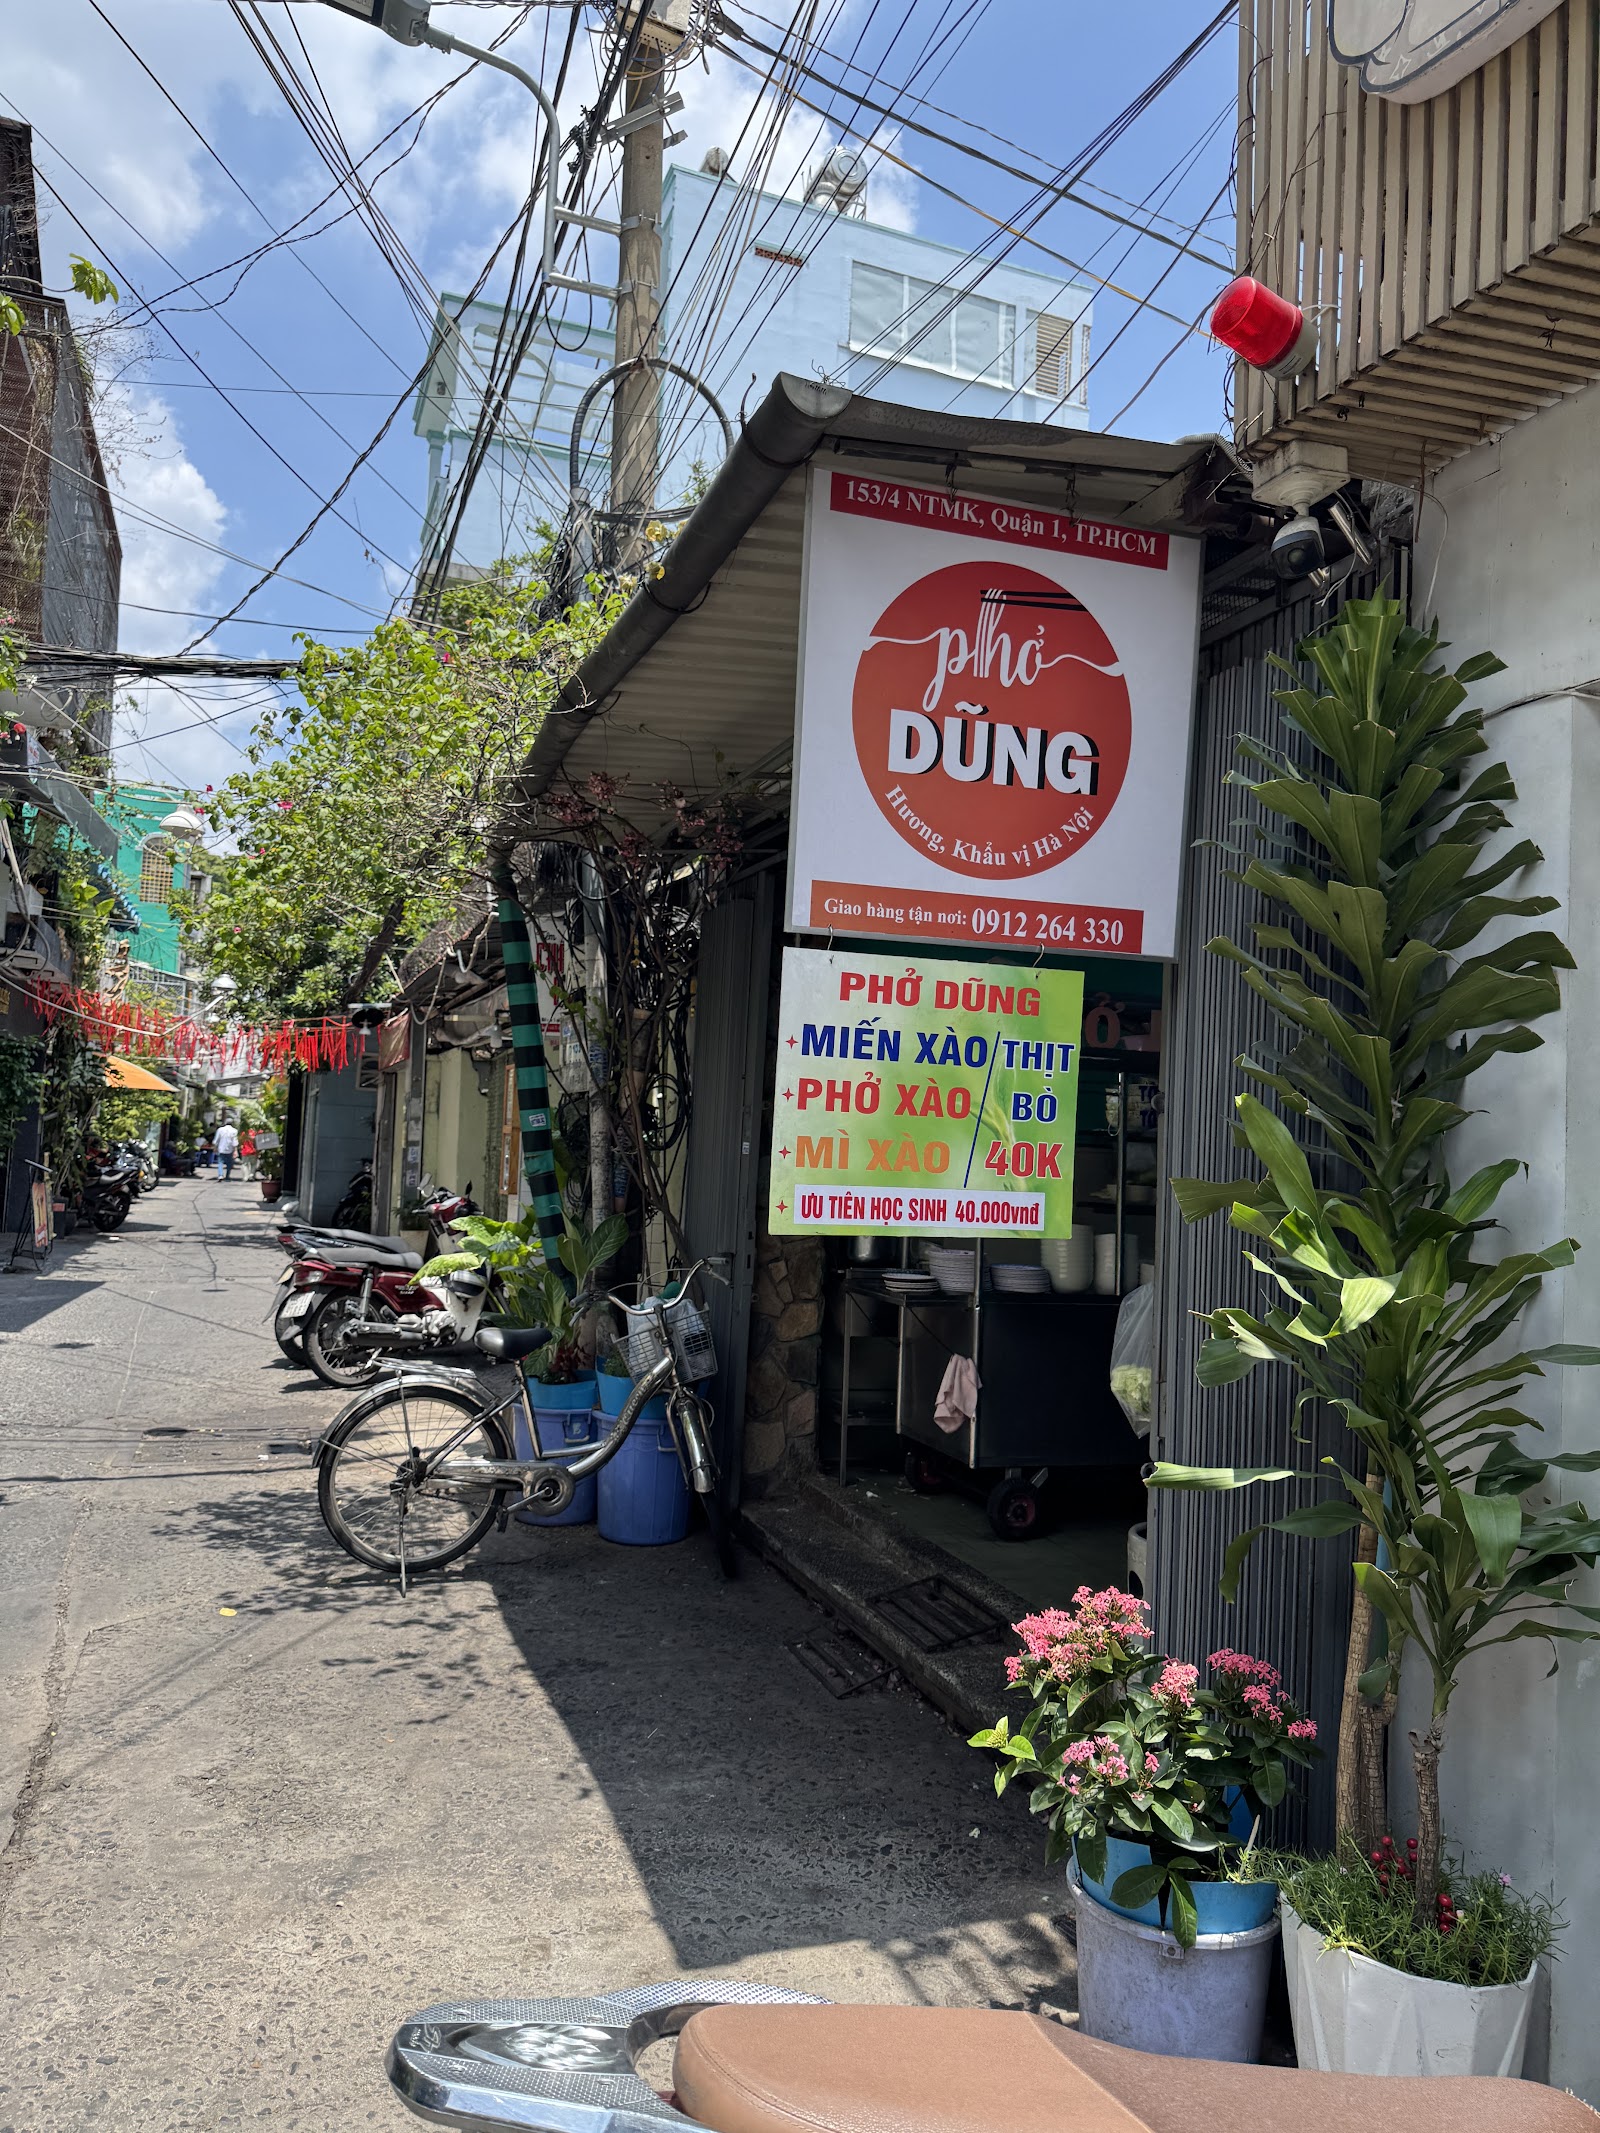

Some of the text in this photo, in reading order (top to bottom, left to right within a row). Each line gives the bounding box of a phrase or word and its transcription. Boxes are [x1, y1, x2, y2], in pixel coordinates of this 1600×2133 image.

[846, 480, 1157, 556] 153/4 NTMK, Quận 1, TP.HCM
[921, 588, 1047, 713] phở
[887, 701, 1100, 796] DŨNG
[885, 784, 1094, 867] Hương, Khẩu vị Hà Nội
[824, 898, 1124, 946] Giao hàng tận nơi: 0912 264 330
[839, 967, 1041, 1017] PHỞ DŨNG
[801, 1016, 988, 1068] MIẾN XÀO
[1001, 1038, 1076, 1079] THỊT
[797, 1071, 971, 1119] PHỞ XÀO
[1011, 1086, 1058, 1124] BÒ
[795, 1128, 950, 1174] MÌ XÀO
[984, 1140, 1064, 1180] 40K
[801, 1191, 1040, 1226] ƯU TIÊN HỌC SINH 40.000vnđ
